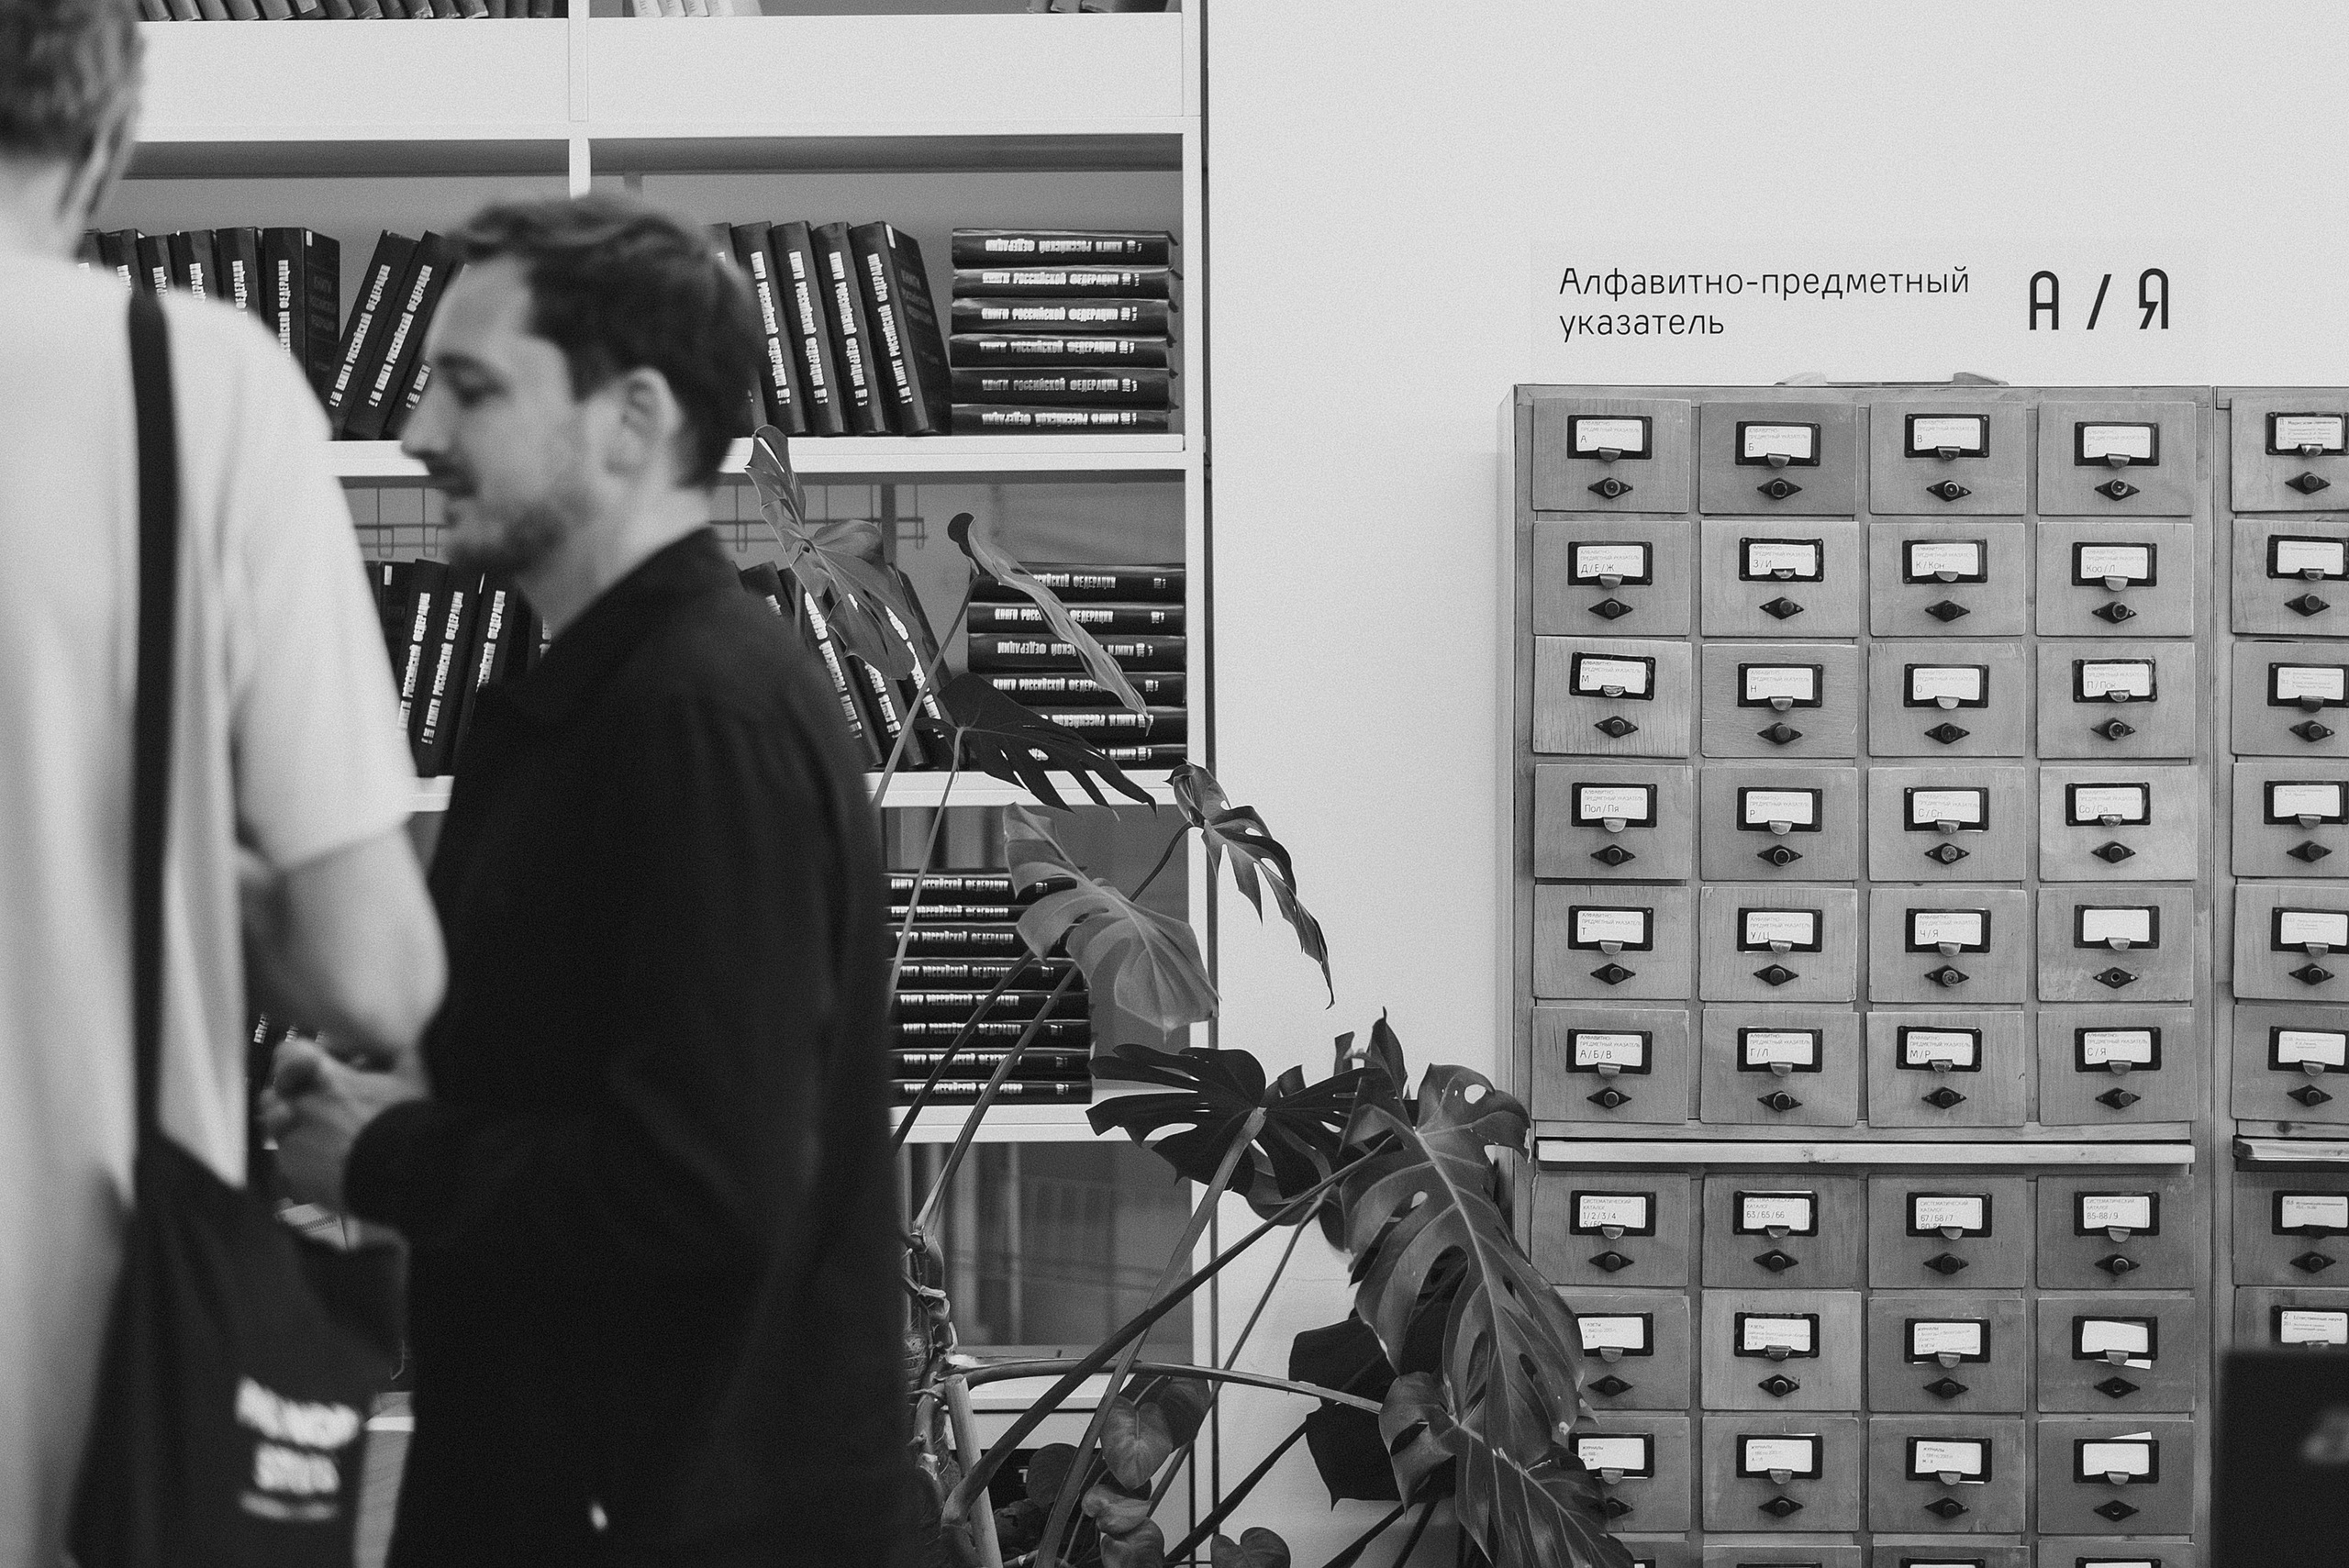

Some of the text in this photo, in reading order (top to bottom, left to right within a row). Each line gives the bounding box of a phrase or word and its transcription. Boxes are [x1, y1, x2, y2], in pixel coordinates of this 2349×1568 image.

[1559, 265, 1970, 302] Алфавитно-предметный
[2029, 270, 2060, 330] А
[2139, 268, 2170, 330] Я
[1559, 313, 1725, 343] указатель
[1580, 435, 1586, 443] А
[1916, 684, 1922, 693] О
